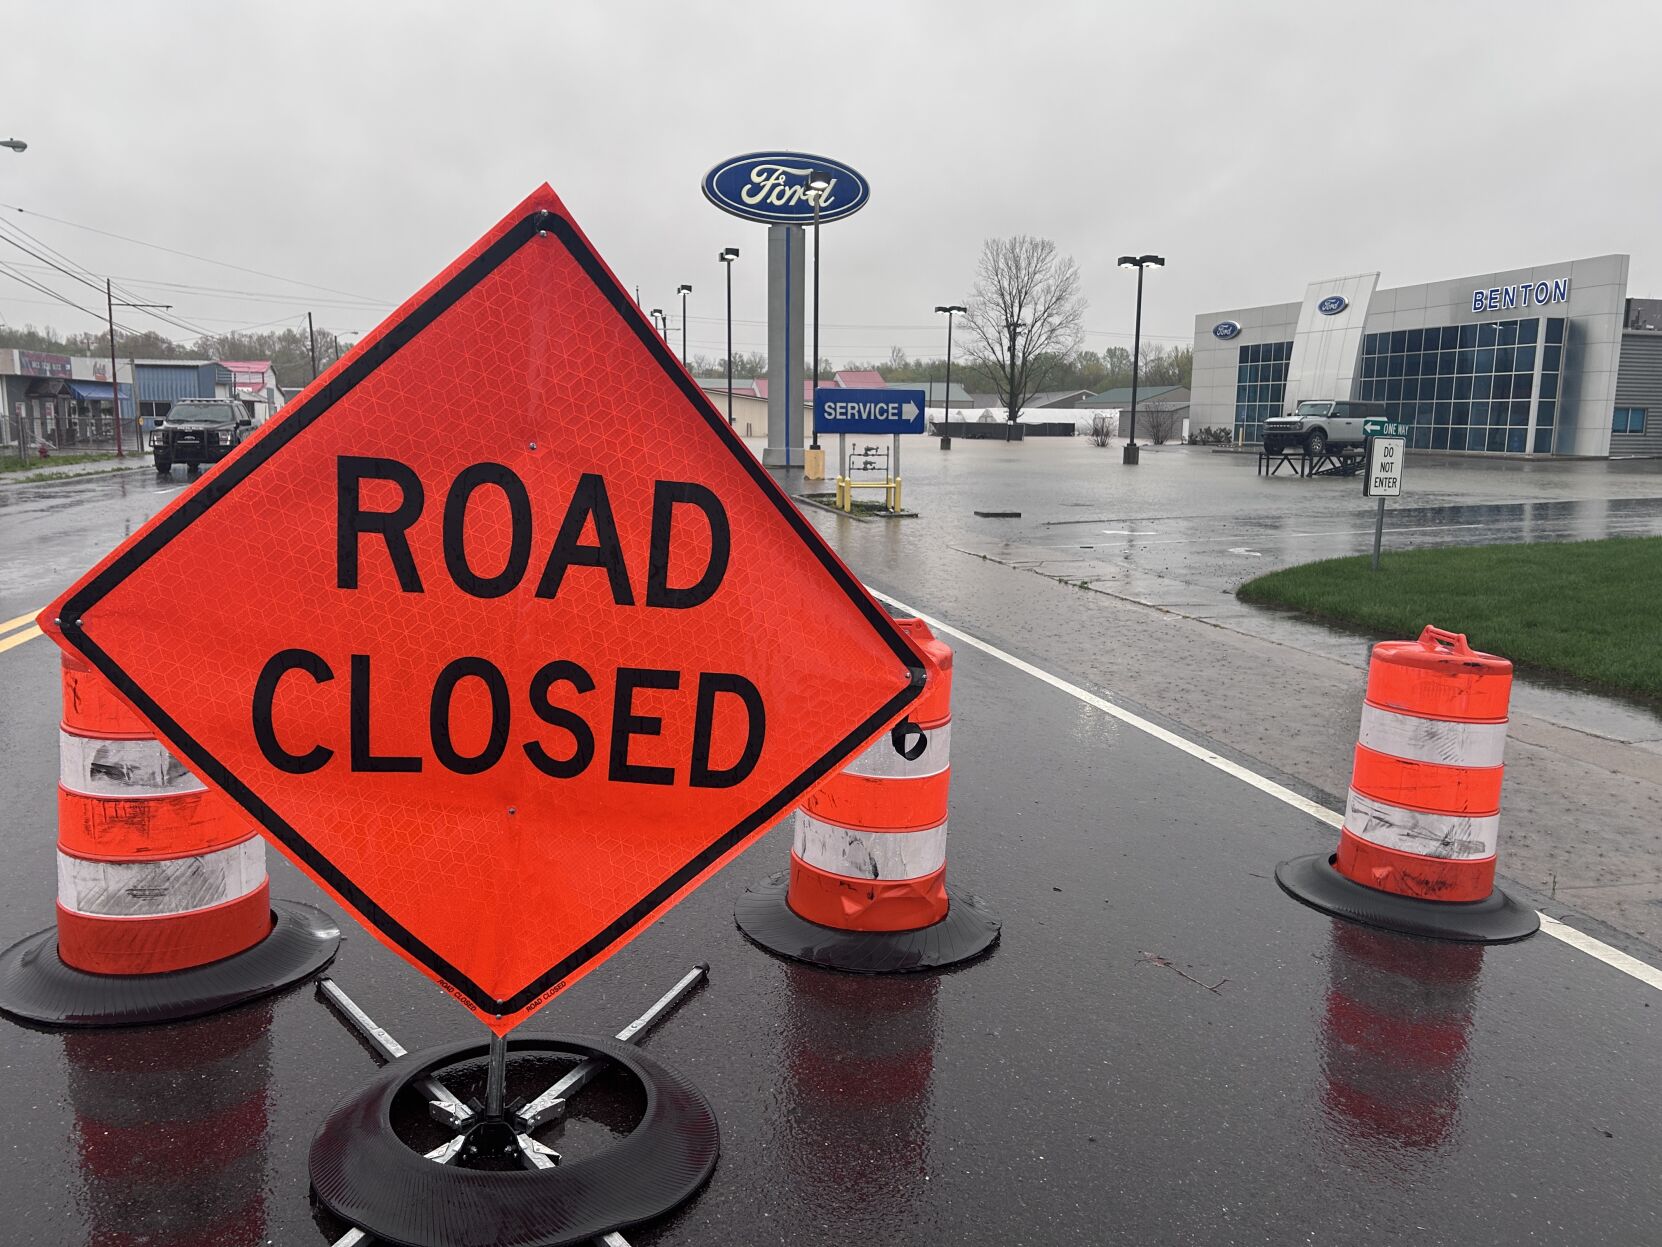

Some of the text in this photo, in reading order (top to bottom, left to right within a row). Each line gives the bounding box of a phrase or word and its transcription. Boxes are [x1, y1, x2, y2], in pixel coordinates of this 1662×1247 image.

[741, 164, 838, 207] Ford
[1472, 278, 1568, 312] BENTON
[824, 402, 898, 420] SERVICE
[1383, 423, 1409, 436] ONE WAY
[1380, 461, 1394, 473] NOT
[1383, 446, 1394, 458] DO
[1374, 477, 1398, 488] ENTER
[337, 455, 731, 610] ROAD
[252, 648, 766, 789] CLOSED
[437, 979, 477, 1012] ROAD CLOSED
[526, 980, 567, 1013] ROAD CLOSED
